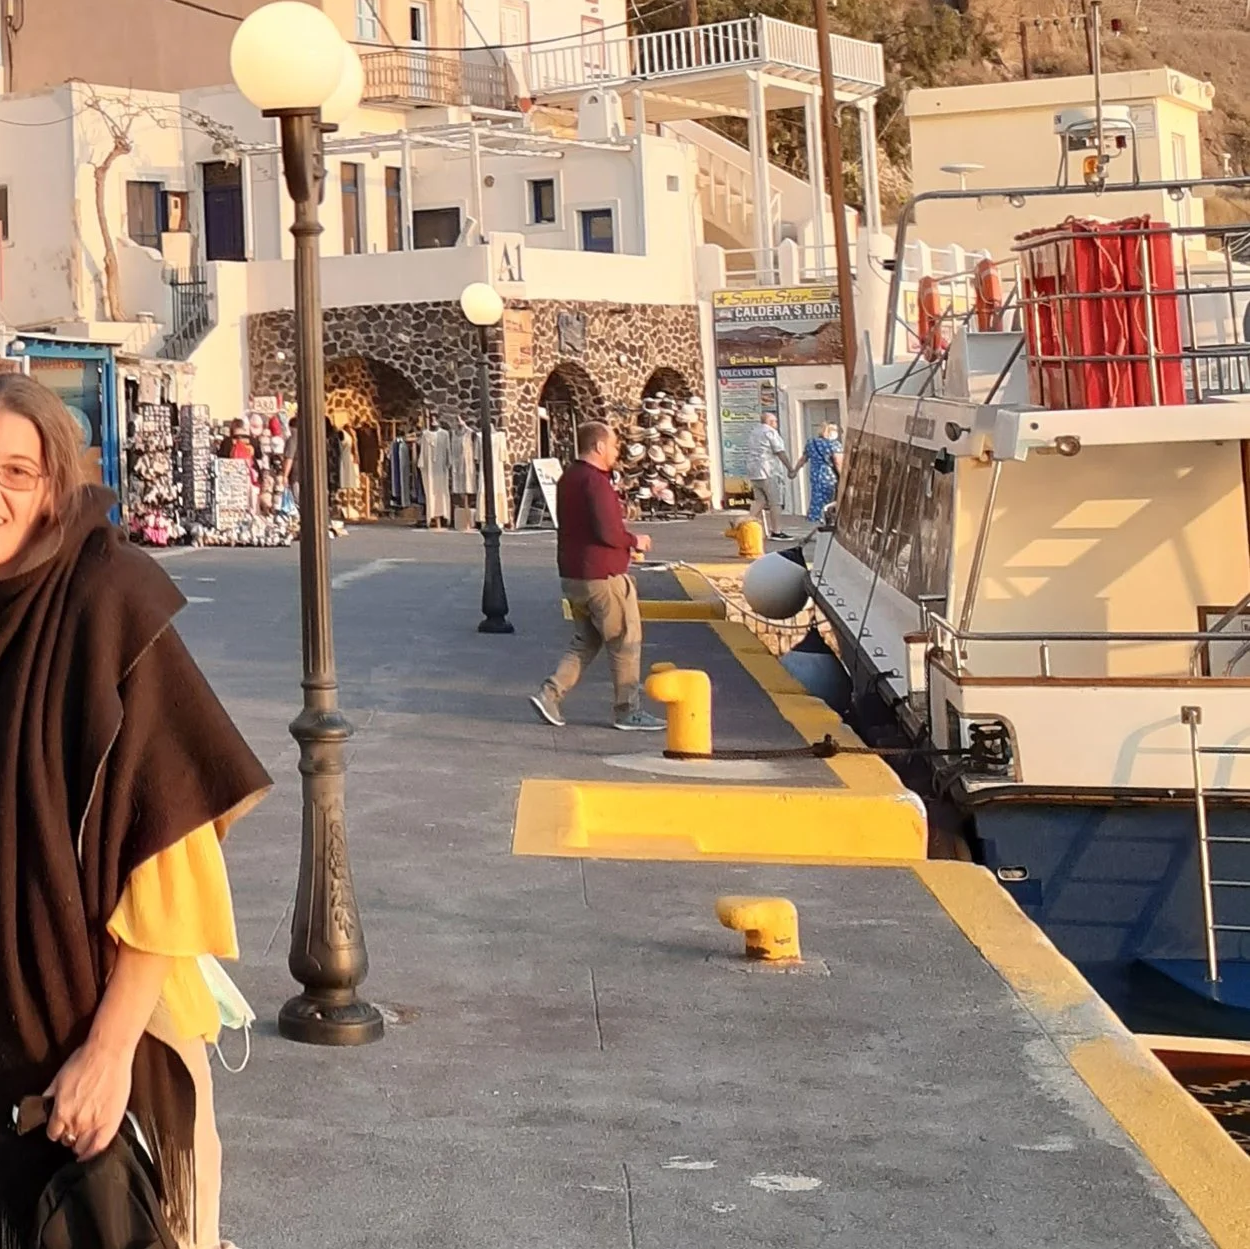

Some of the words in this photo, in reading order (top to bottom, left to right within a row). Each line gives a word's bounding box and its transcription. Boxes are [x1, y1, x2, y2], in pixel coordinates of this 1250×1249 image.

[497, 241, 525, 282] A1
[729, 292, 773, 306] Santo
[773, 289, 808, 303] Star
[735, 304, 802, 318] CALDERA'S
[719, 368, 750, 377] VOLCANO
[752, 368, 774, 376] TOURS
